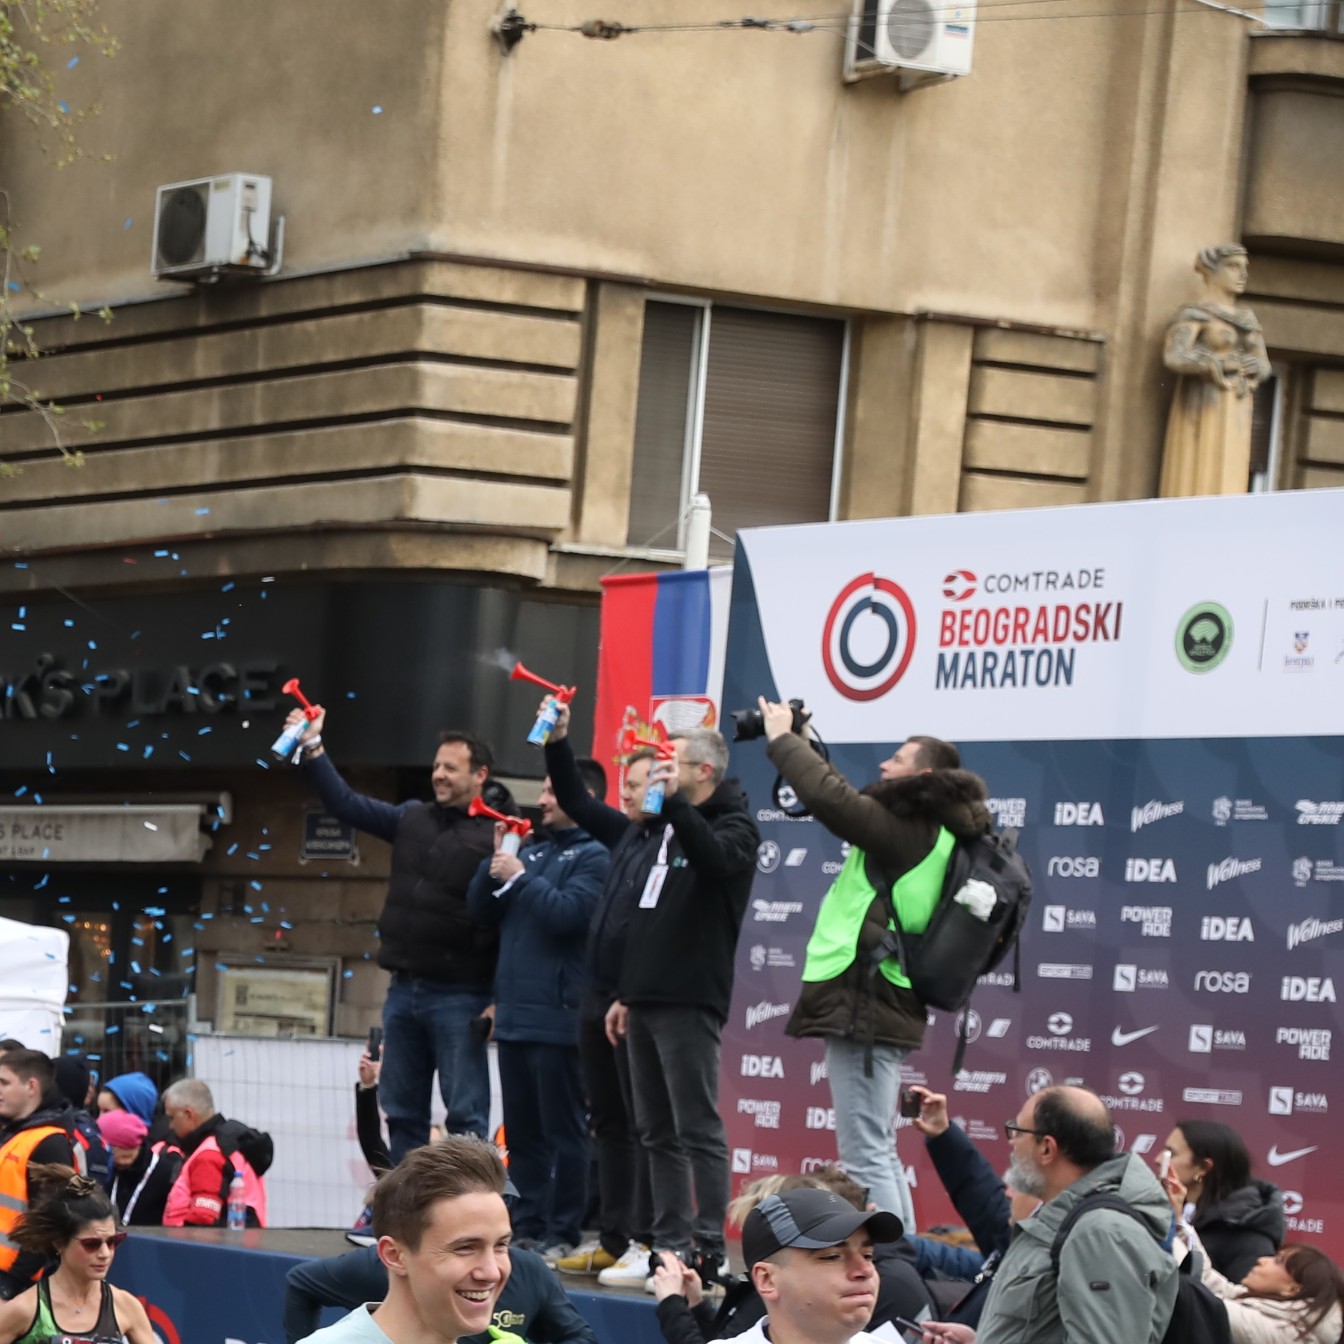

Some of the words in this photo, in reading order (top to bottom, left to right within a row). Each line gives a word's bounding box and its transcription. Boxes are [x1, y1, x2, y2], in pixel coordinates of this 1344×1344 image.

[984, 568, 1106, 594] COMTRADE
[938, 601, 1124, 648] BEOGRADSKI
[935, 647, 1076, 691] MARATON
[92, 660, 280, 713] PLACE
[1131, 799, 1185, 833] Wellness
[11, 823, 64, 840] PLACE
[1048, 856, 1100, 878] rosa
[1206, 856, 1262, 891] Wellness
[1194, 970, 1249, 994] rosa
[1026, 1036, 1092, 1052] COMTRADE
[806, 1107, 837, 1131] iDE
